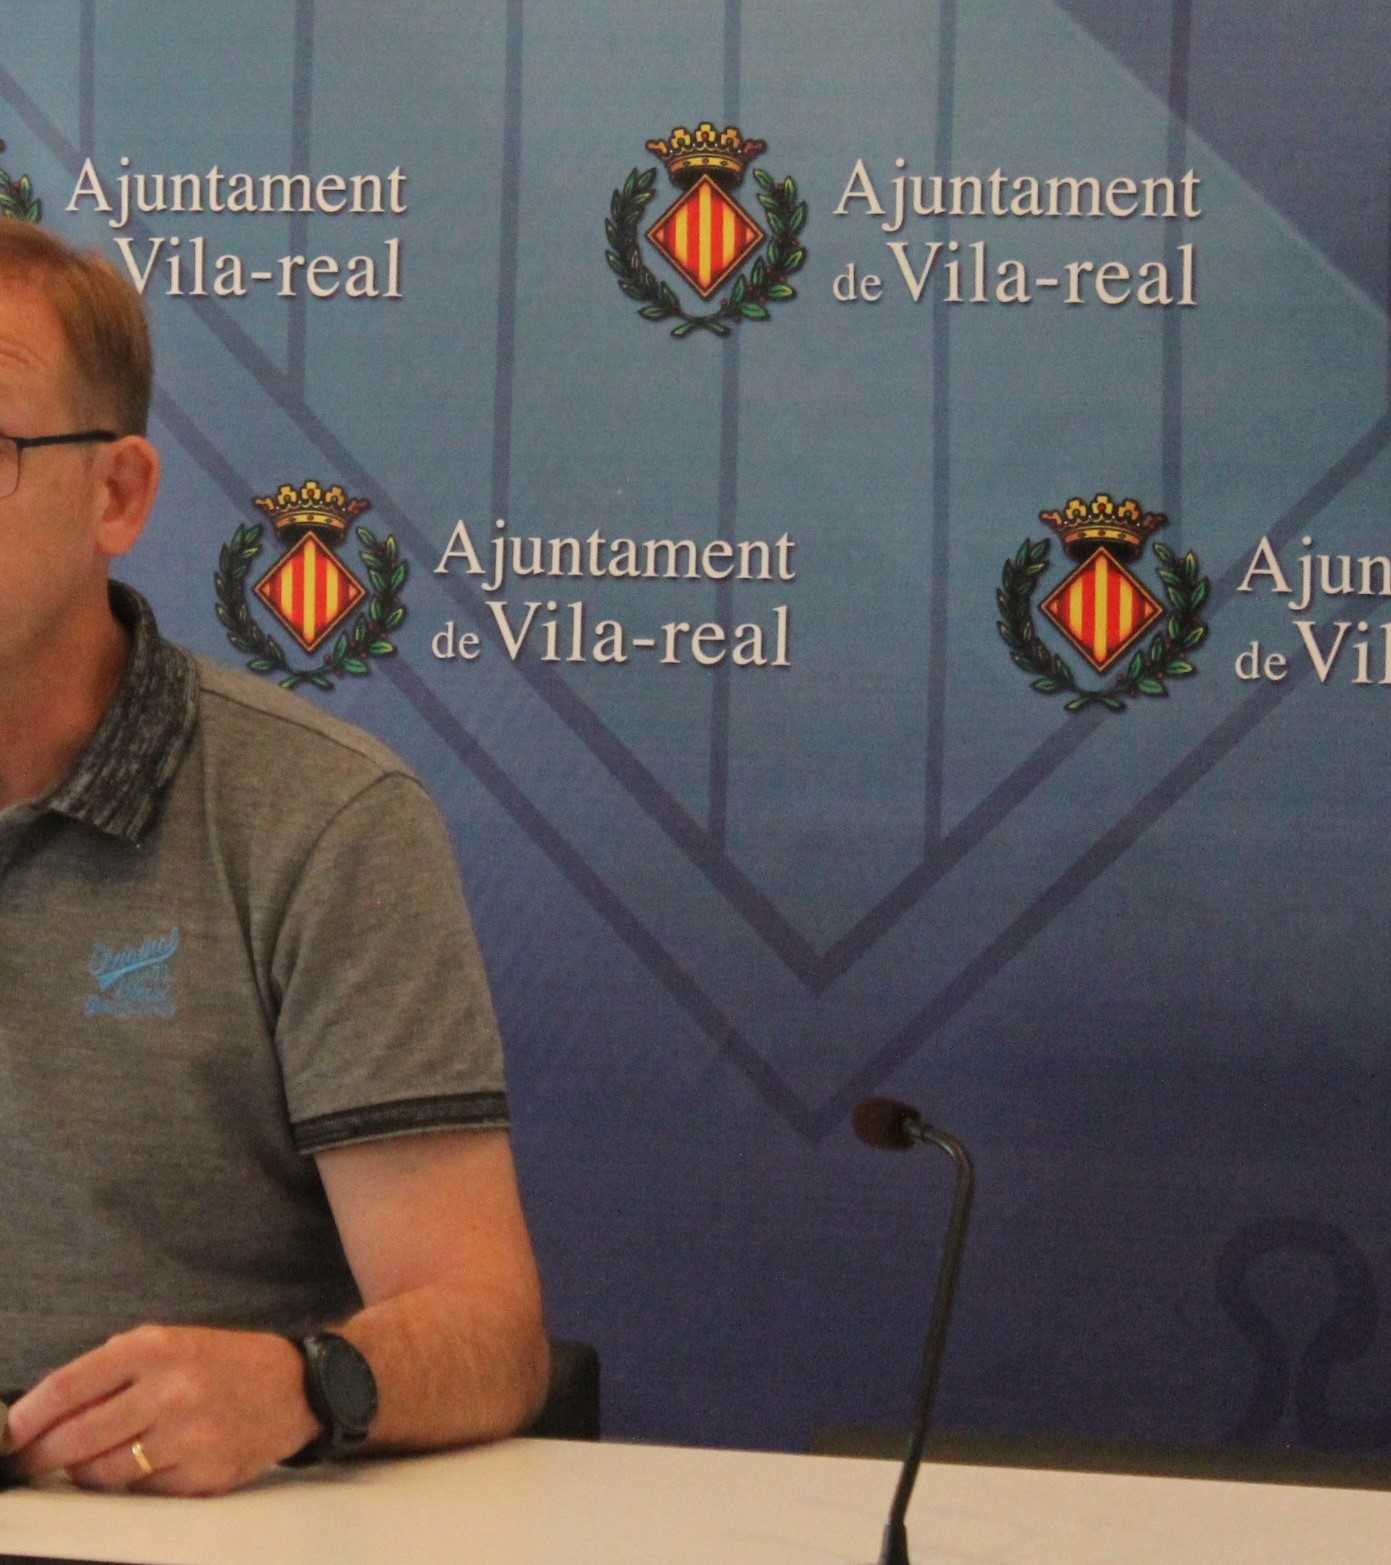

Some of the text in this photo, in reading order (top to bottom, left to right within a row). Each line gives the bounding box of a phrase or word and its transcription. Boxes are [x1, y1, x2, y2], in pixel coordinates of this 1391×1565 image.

[64, 156, 408, 229] Ajuntament
[831, 157, 1203, 232] Ajuntament
[113, 235, 404, 298] Vila-real
[831, 240, 1198, 306] de Vila-real
[433, 518, 797, 591] Ajuntament
[431, 600, 792, 667] de Vila-real
[1234, 640, 1289, 681] de
